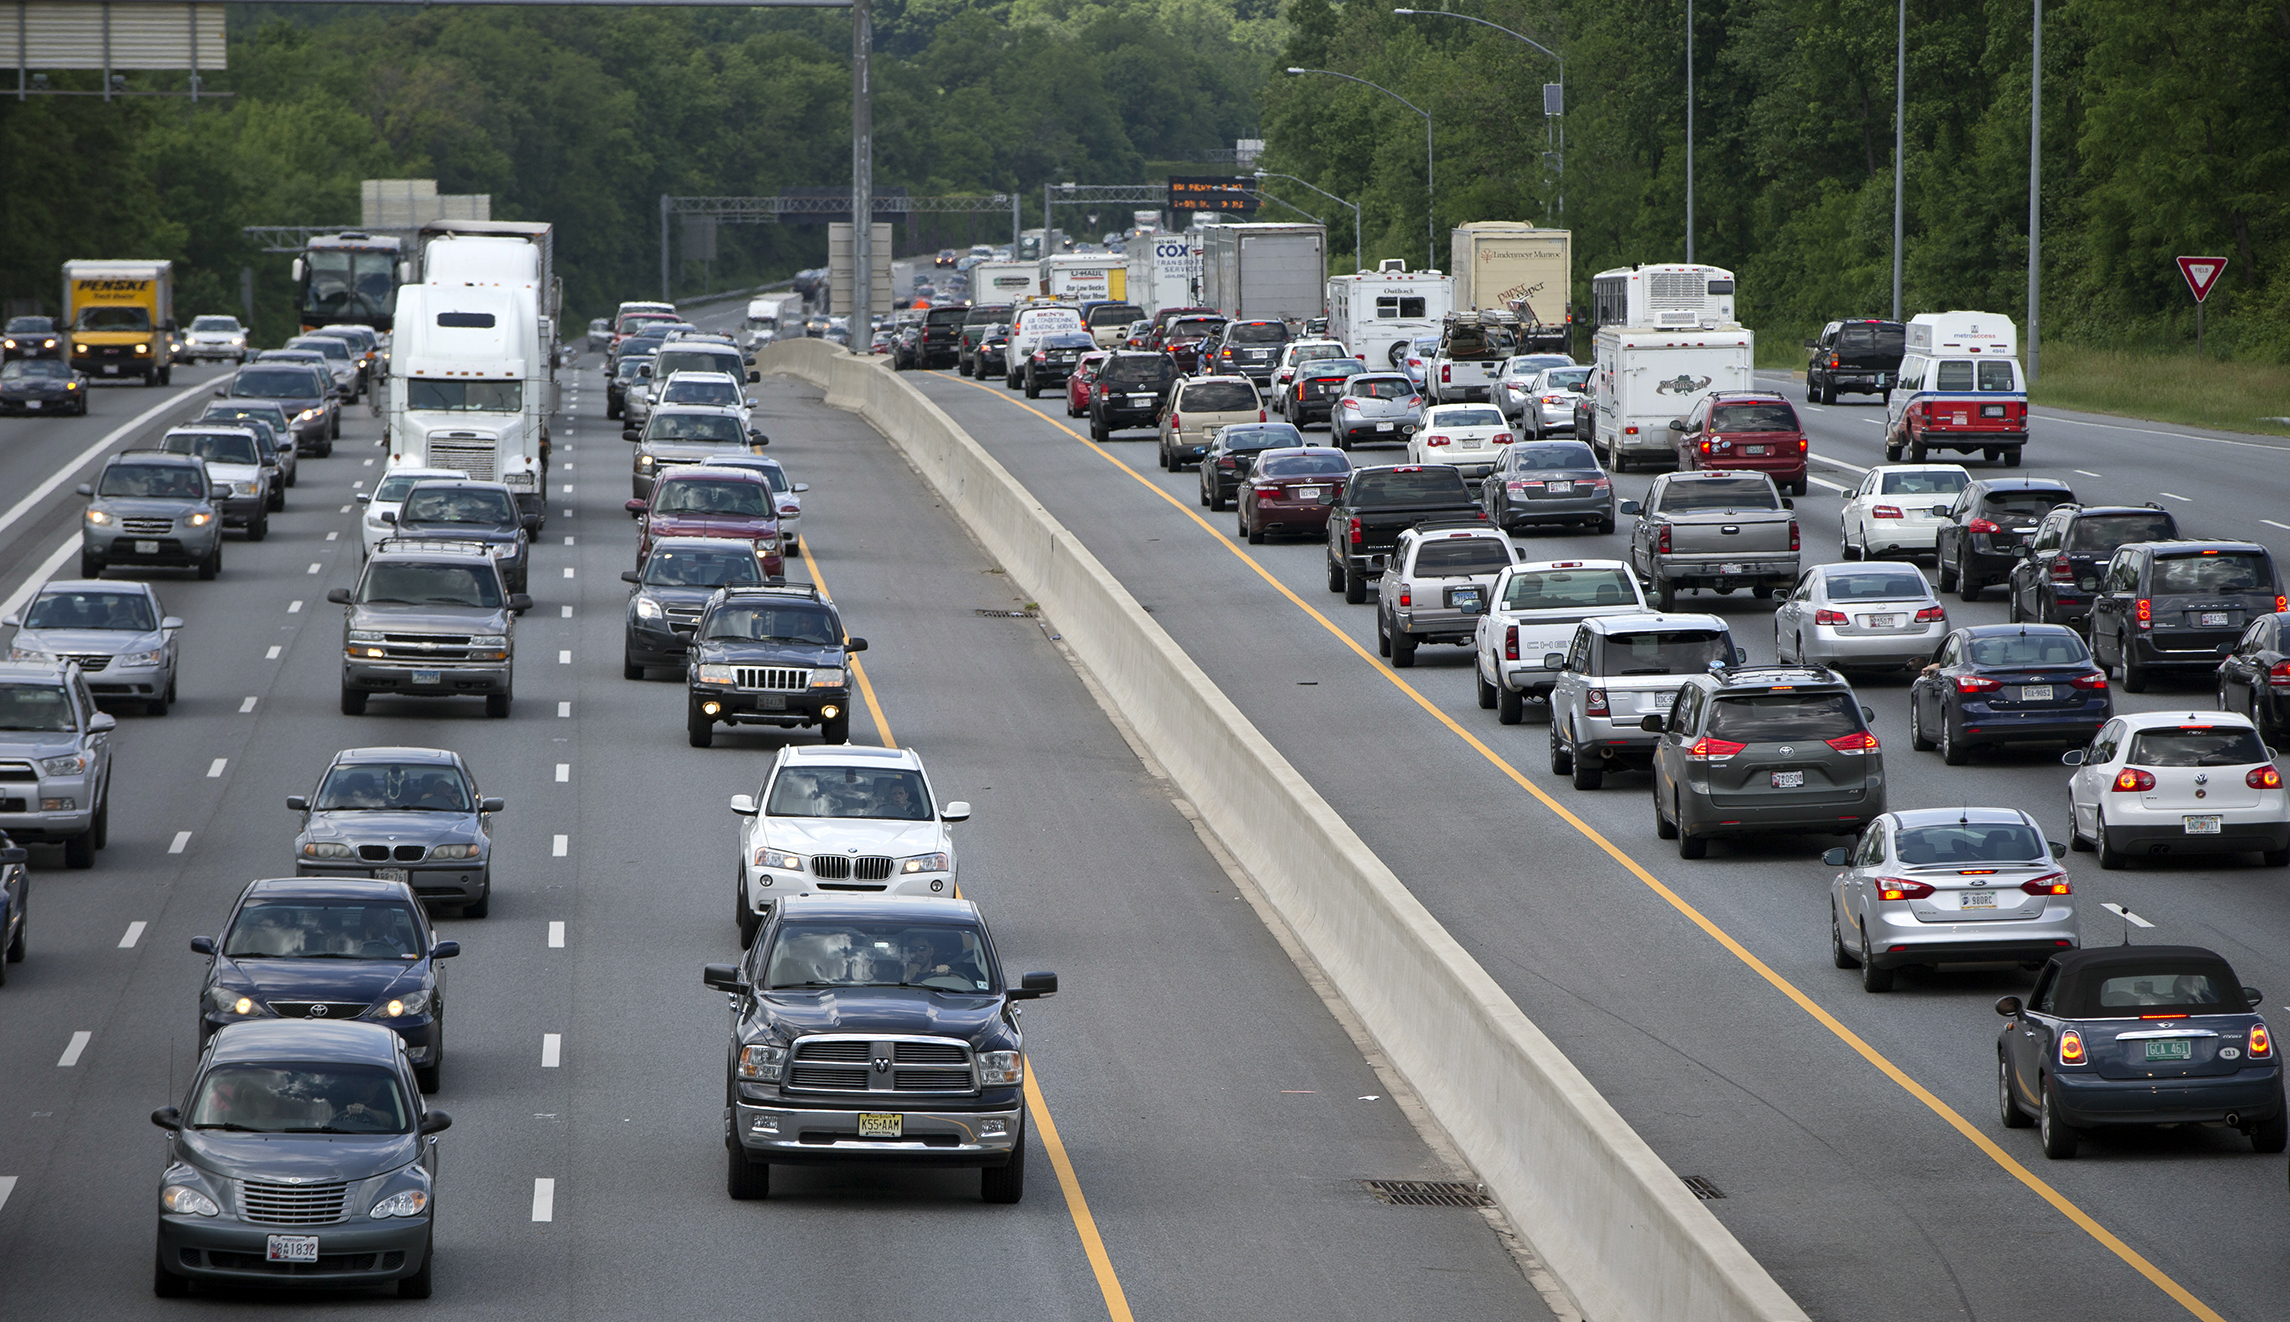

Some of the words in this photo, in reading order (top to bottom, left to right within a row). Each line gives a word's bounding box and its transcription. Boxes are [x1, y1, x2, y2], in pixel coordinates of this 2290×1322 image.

[1156, 244, 1190, 258] COX
[78, 280, 151, 291] PENSKE
[1497, 283, 1526, 305] paper
[2149, 1043, 2166, 1055] GCA
[2170, 1043, 2187, 1055] 461
